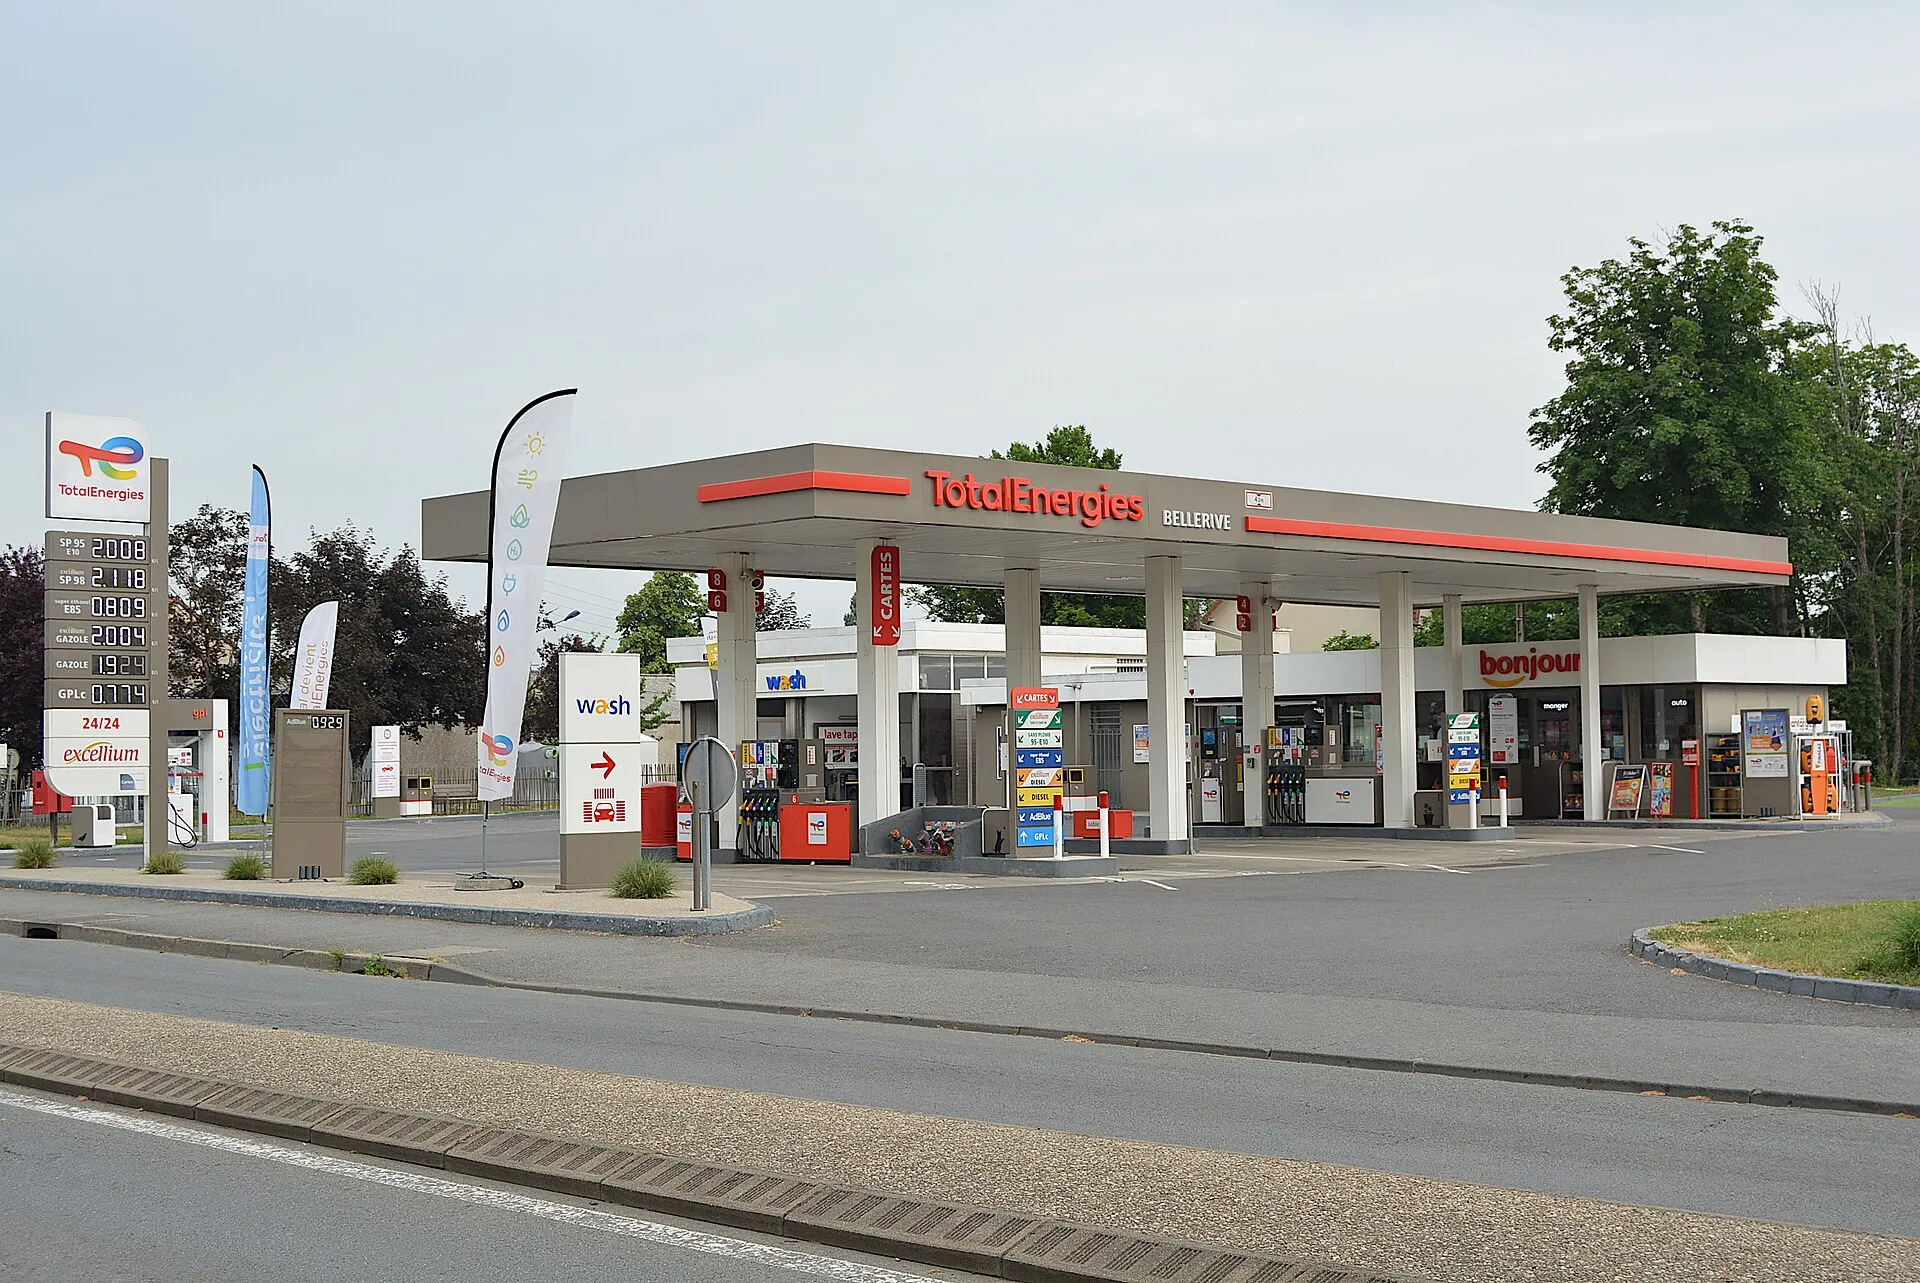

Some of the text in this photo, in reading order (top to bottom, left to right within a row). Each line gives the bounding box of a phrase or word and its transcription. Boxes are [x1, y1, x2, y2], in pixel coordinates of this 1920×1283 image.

[58, 484, 144, 501] TotalEnergies
[925, 470, 1144, 528] TotalEnergies
[1163, 508, 1232, 530] BELLERIVE
[60, 538, 85, 548] SP 95
[92, 538, 146, 560] 2.008
[66, 548, 79, 556] E10
[60, 576, 85, 585] SP 98
[92, 568, 146, 589] 2.118
[714, 573, 721, 586] 8
[880, 552, 892, 620] CARTES
[92, 597, 146, 617] 0.809
[714, 595, 721, 607] 6
[1242, 599, 1246, 609] 4
[64, 606, 81, 614] E85
[1241, 618, 1246, 627] 2
[56, 635, 88, 643] GAZOLE
[92, 626, 146, 646] 2.004
[98, 656, 145, 674] 1.924
[300, 641, 316, 694] devient
[1480, 647, 1580, 680] bonjour
[766, 669, 806, 690] wash
[58, 689, 86, 699] GPLc
[92, 684, 146, 704] 0.774
[1024, 694, 1048, 702] CARTES
[576, 695, 630, 715] wash
[1543, 703, 1568, 711] manger
[193, 708, 208, 720] gpl
[82, 718, 120, 729] 24/24
[312, 717, 343, 728] 0929
[824, 729, 858, 741] lave tap
[64, 744, 139, 762] excellium
